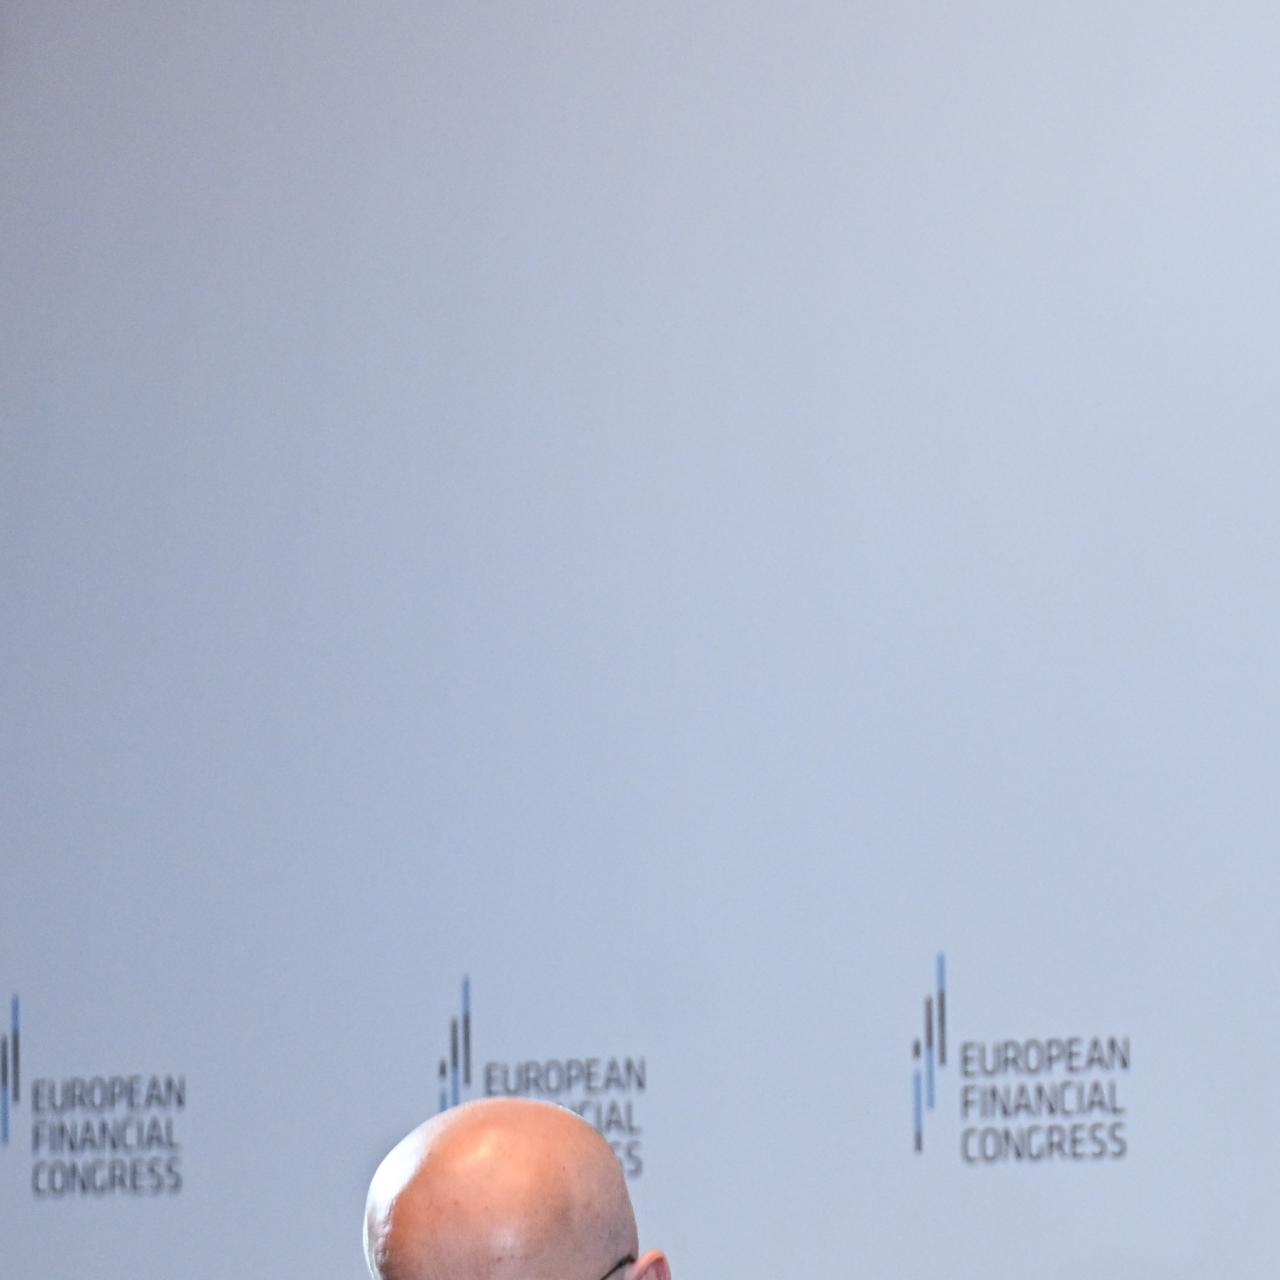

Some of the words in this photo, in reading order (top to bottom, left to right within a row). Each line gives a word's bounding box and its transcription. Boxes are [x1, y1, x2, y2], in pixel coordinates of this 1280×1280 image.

[485, 1056, 646, 1097] EUROPEAN
[960, 1036, 1131, 1079] EUROPEAN
[32, 1073, 186, 1117] EUROPEAN
[961, 1080, 1127, 1121] FINANCIAL
[32, 1117, 180, 1157] FINANCIAL
[961, 1121, 1128, 1165] CONGRESS
[32, 1156, 183, 1200] CONGRESS
